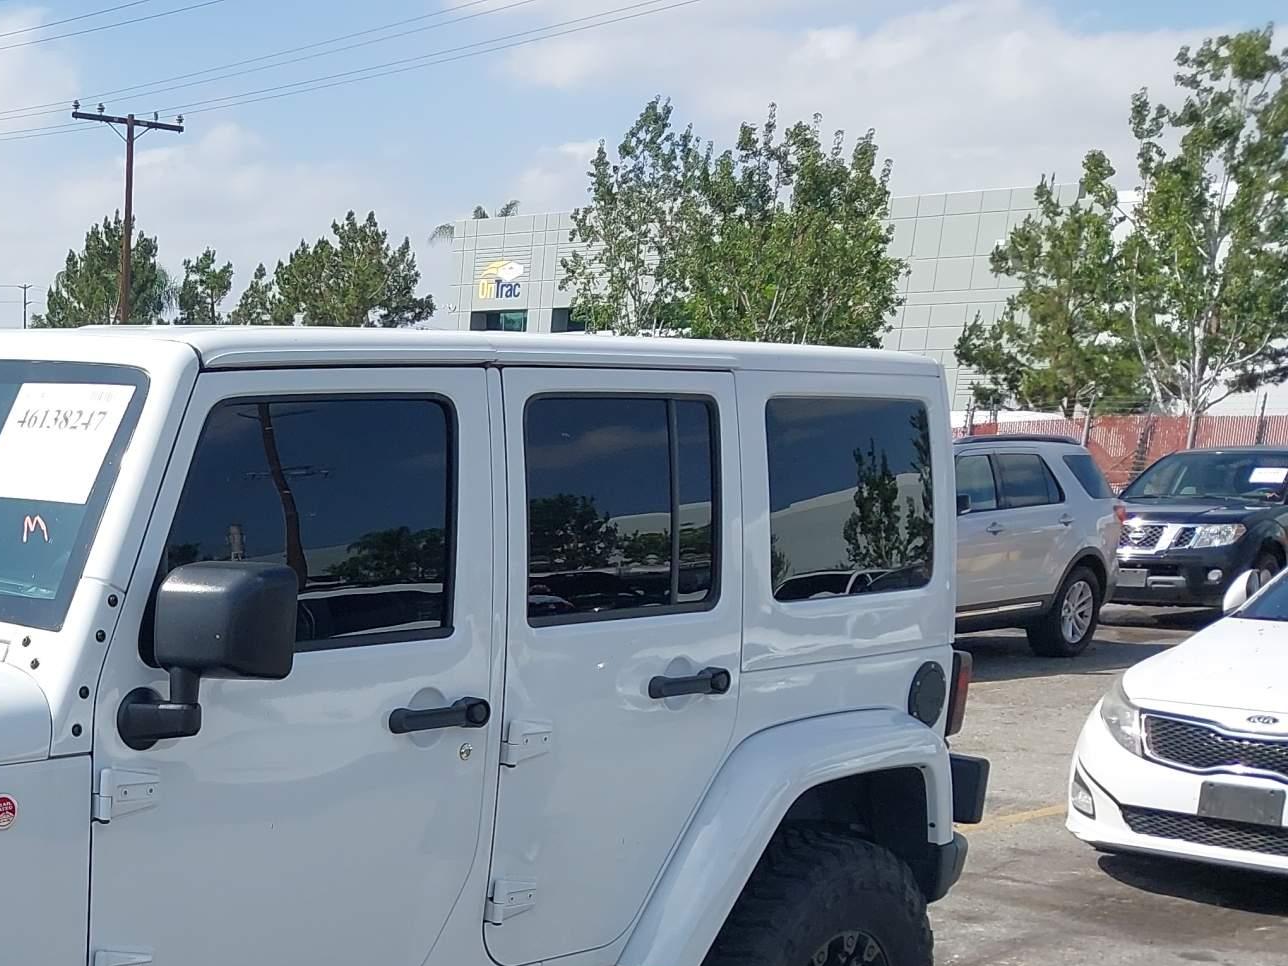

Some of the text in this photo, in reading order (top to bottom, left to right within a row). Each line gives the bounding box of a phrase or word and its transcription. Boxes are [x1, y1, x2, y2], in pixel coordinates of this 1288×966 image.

[478, 279, 521, 299] OnTrac
[16, 408, 108, 431] 46138247
[23, 515, 49, 543] M
